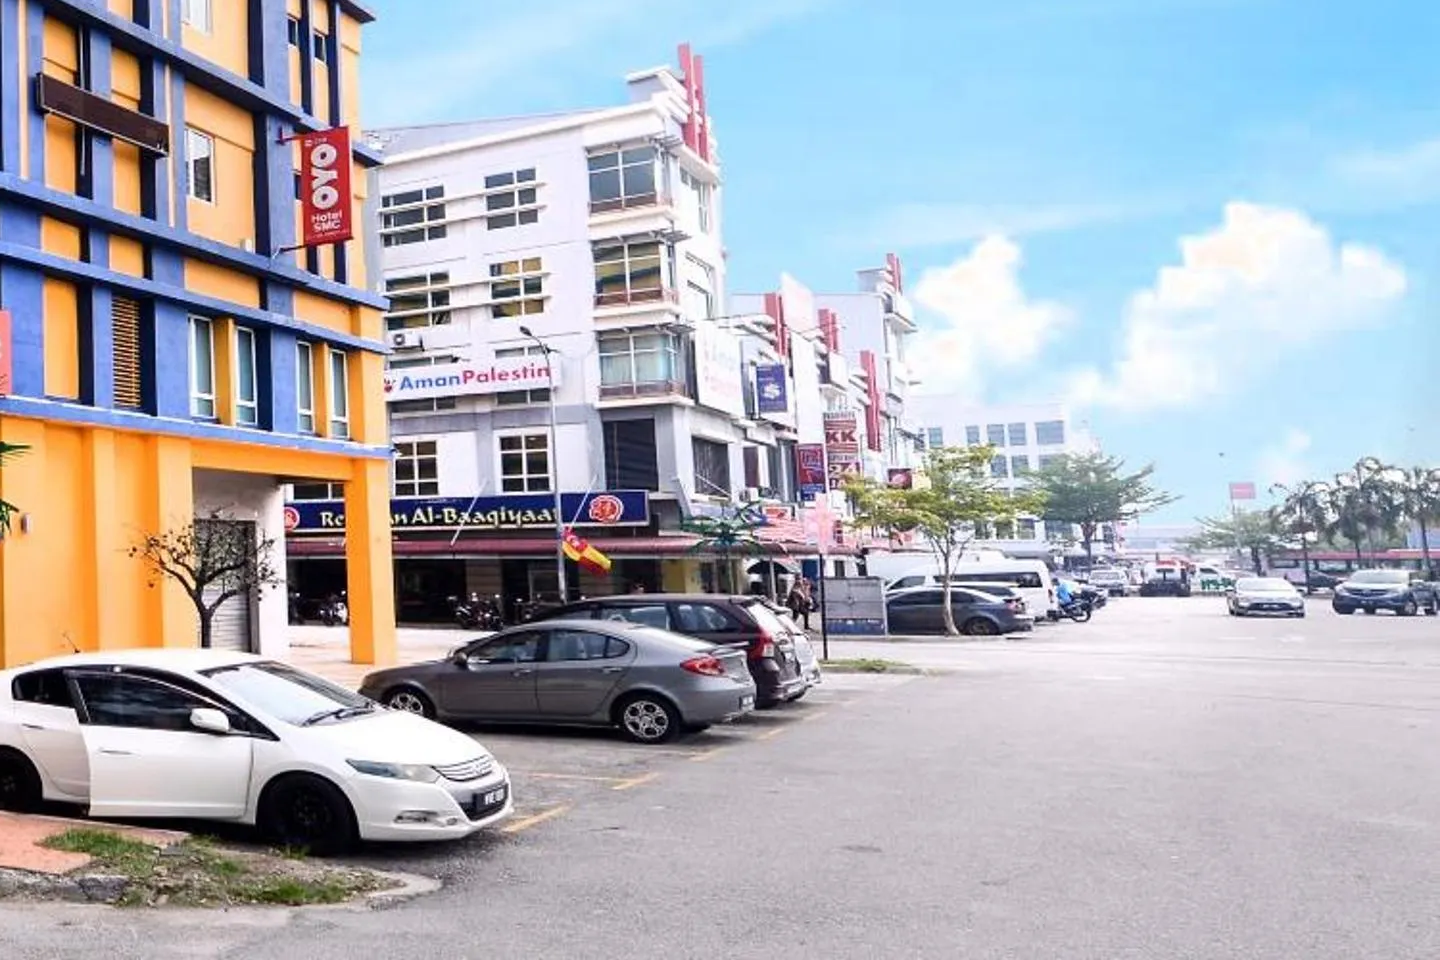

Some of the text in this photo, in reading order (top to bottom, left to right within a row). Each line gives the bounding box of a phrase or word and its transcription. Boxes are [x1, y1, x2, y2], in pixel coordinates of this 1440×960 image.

[311, 143, 338, 210] OYO
[311, 209, 342, 224] Hotel
[313, 220, 341, 233] SMC
[825, 430, 857, 443] KK
